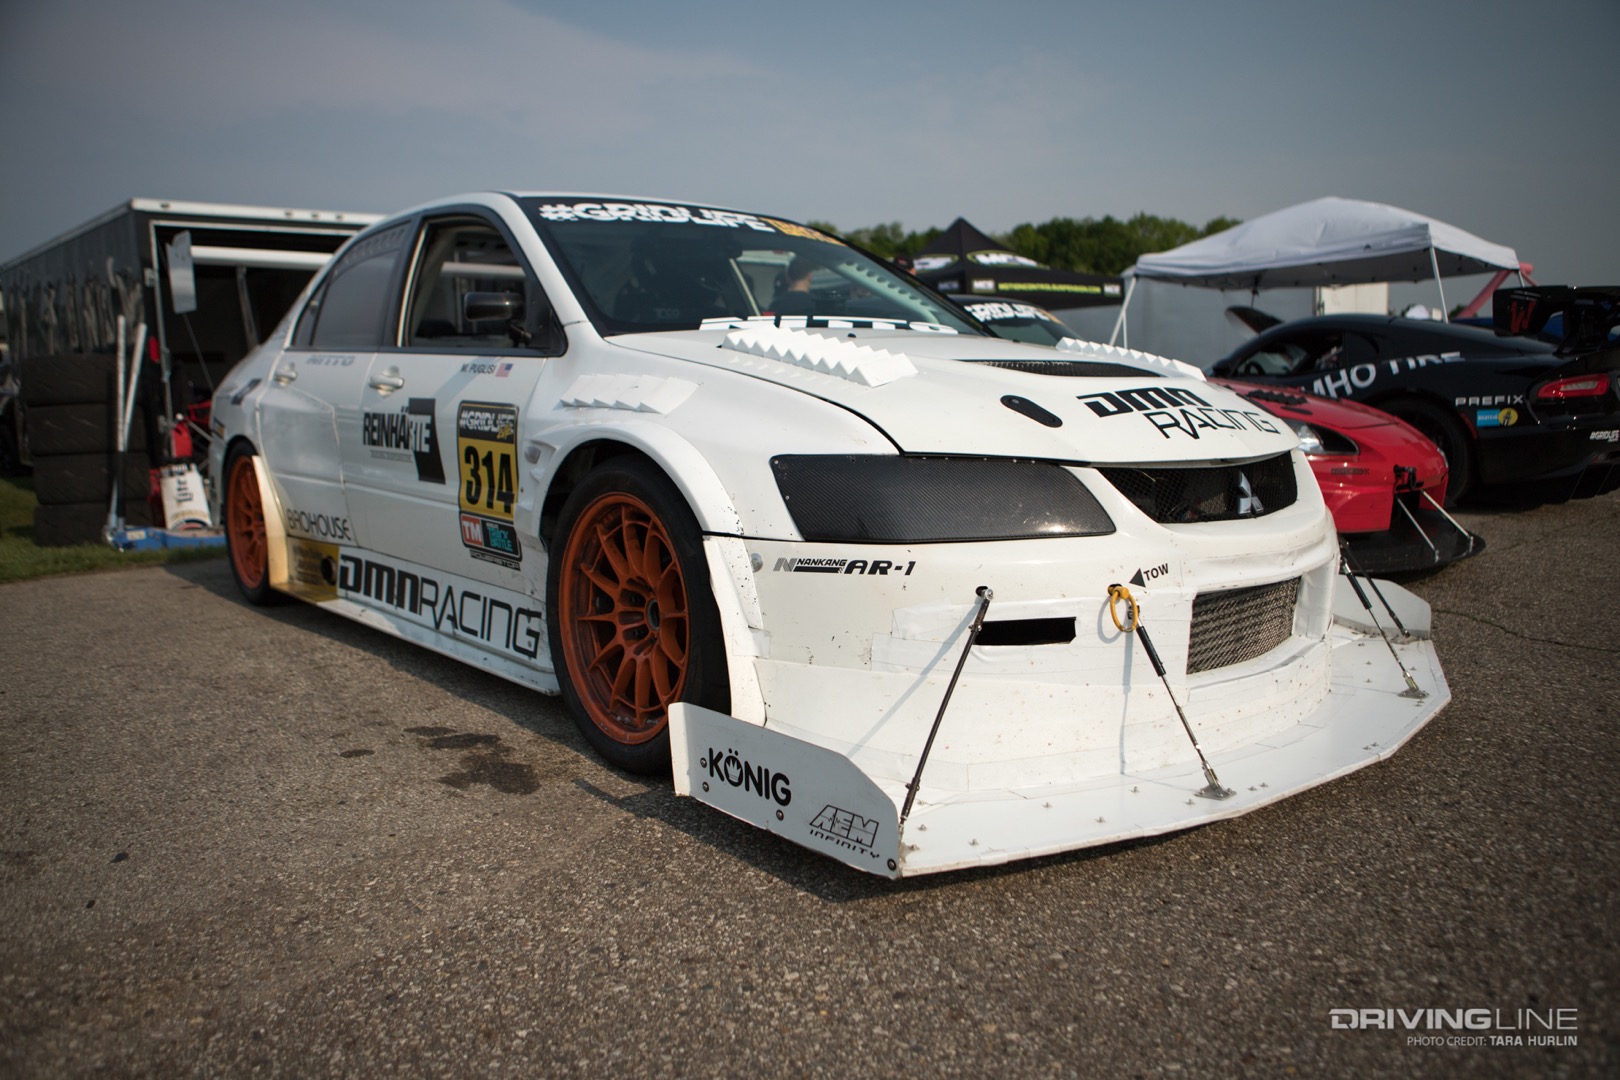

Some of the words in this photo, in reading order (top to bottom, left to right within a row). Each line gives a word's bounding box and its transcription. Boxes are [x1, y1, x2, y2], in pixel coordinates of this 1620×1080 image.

[539, 203, 776, 232] #GRIDLIFE
[1455, 395, 1523, 407] PREFIX
[1143, 408, 1281, 440] RACING
[464, 446, 515, 514] 314
[463, 521, 482, 542] TM
[797, 558, 848, 567] NANKANG
[844, 559, 916, 576] AR-1
[1143, 563, 1169, 581] TOW
[709, 747, 792, 806] KÖNIG
[809, 804, 879, 848] AEM
